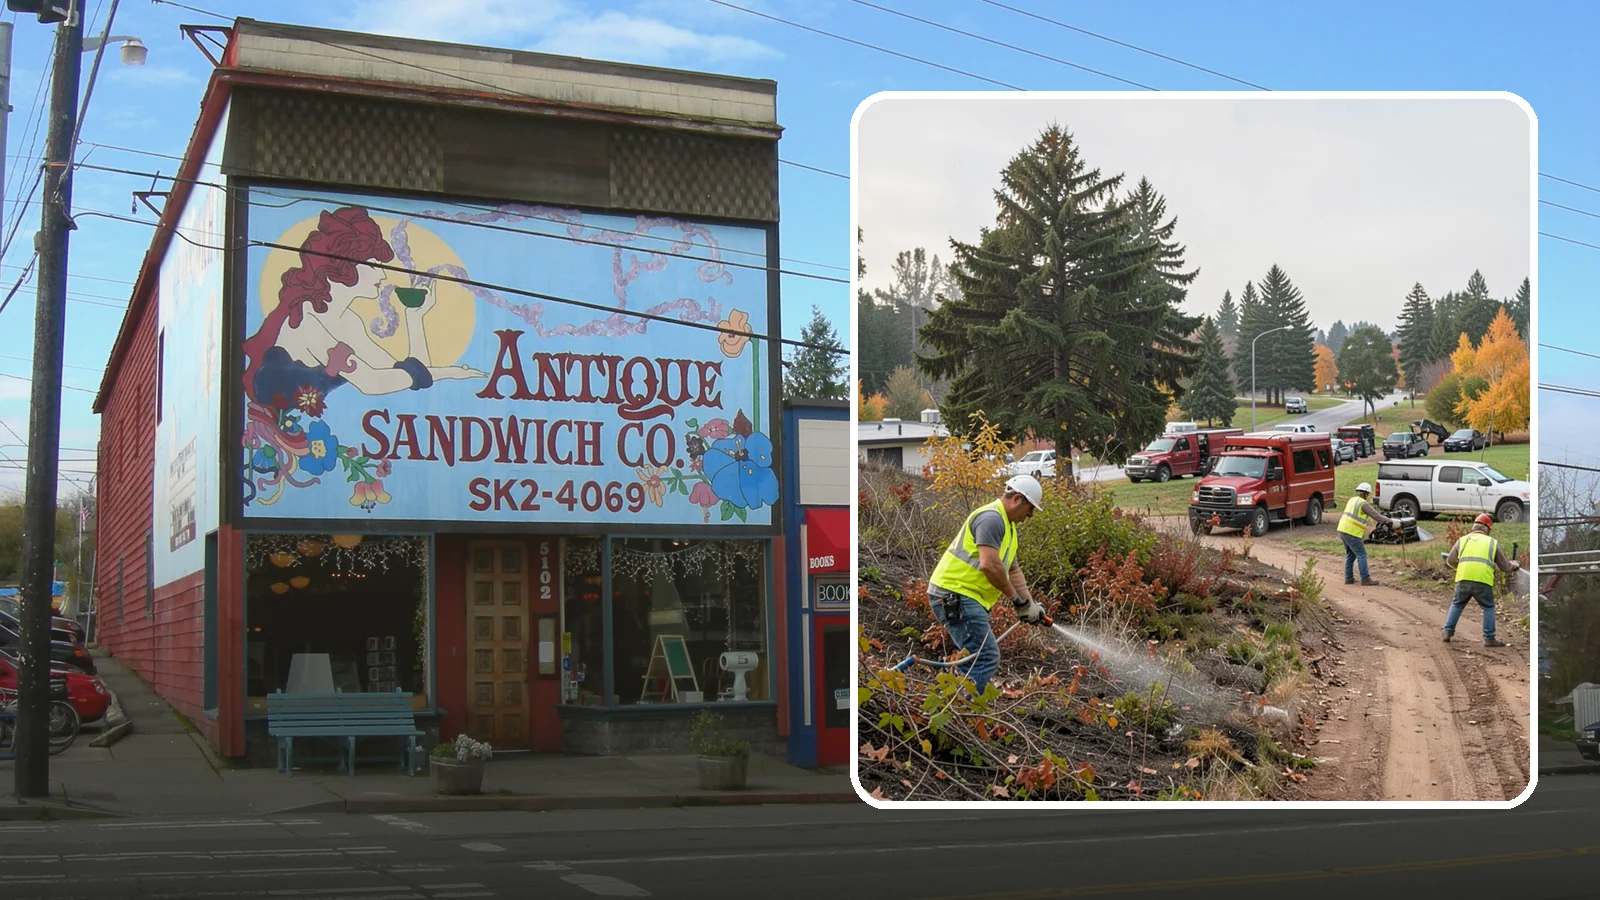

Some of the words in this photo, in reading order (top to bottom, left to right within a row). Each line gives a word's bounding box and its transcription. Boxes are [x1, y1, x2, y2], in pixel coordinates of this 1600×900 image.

[476, 329, 724, 421] ANTIQUE
[362, 409, 604, 468] SANDWICH
[617, 420, 685, 470] CO.
[469, 477, 646, 513] SK2-4069
[539, 541, 551, 600] 5102
[809, 555, 835, 569] BOOKS
